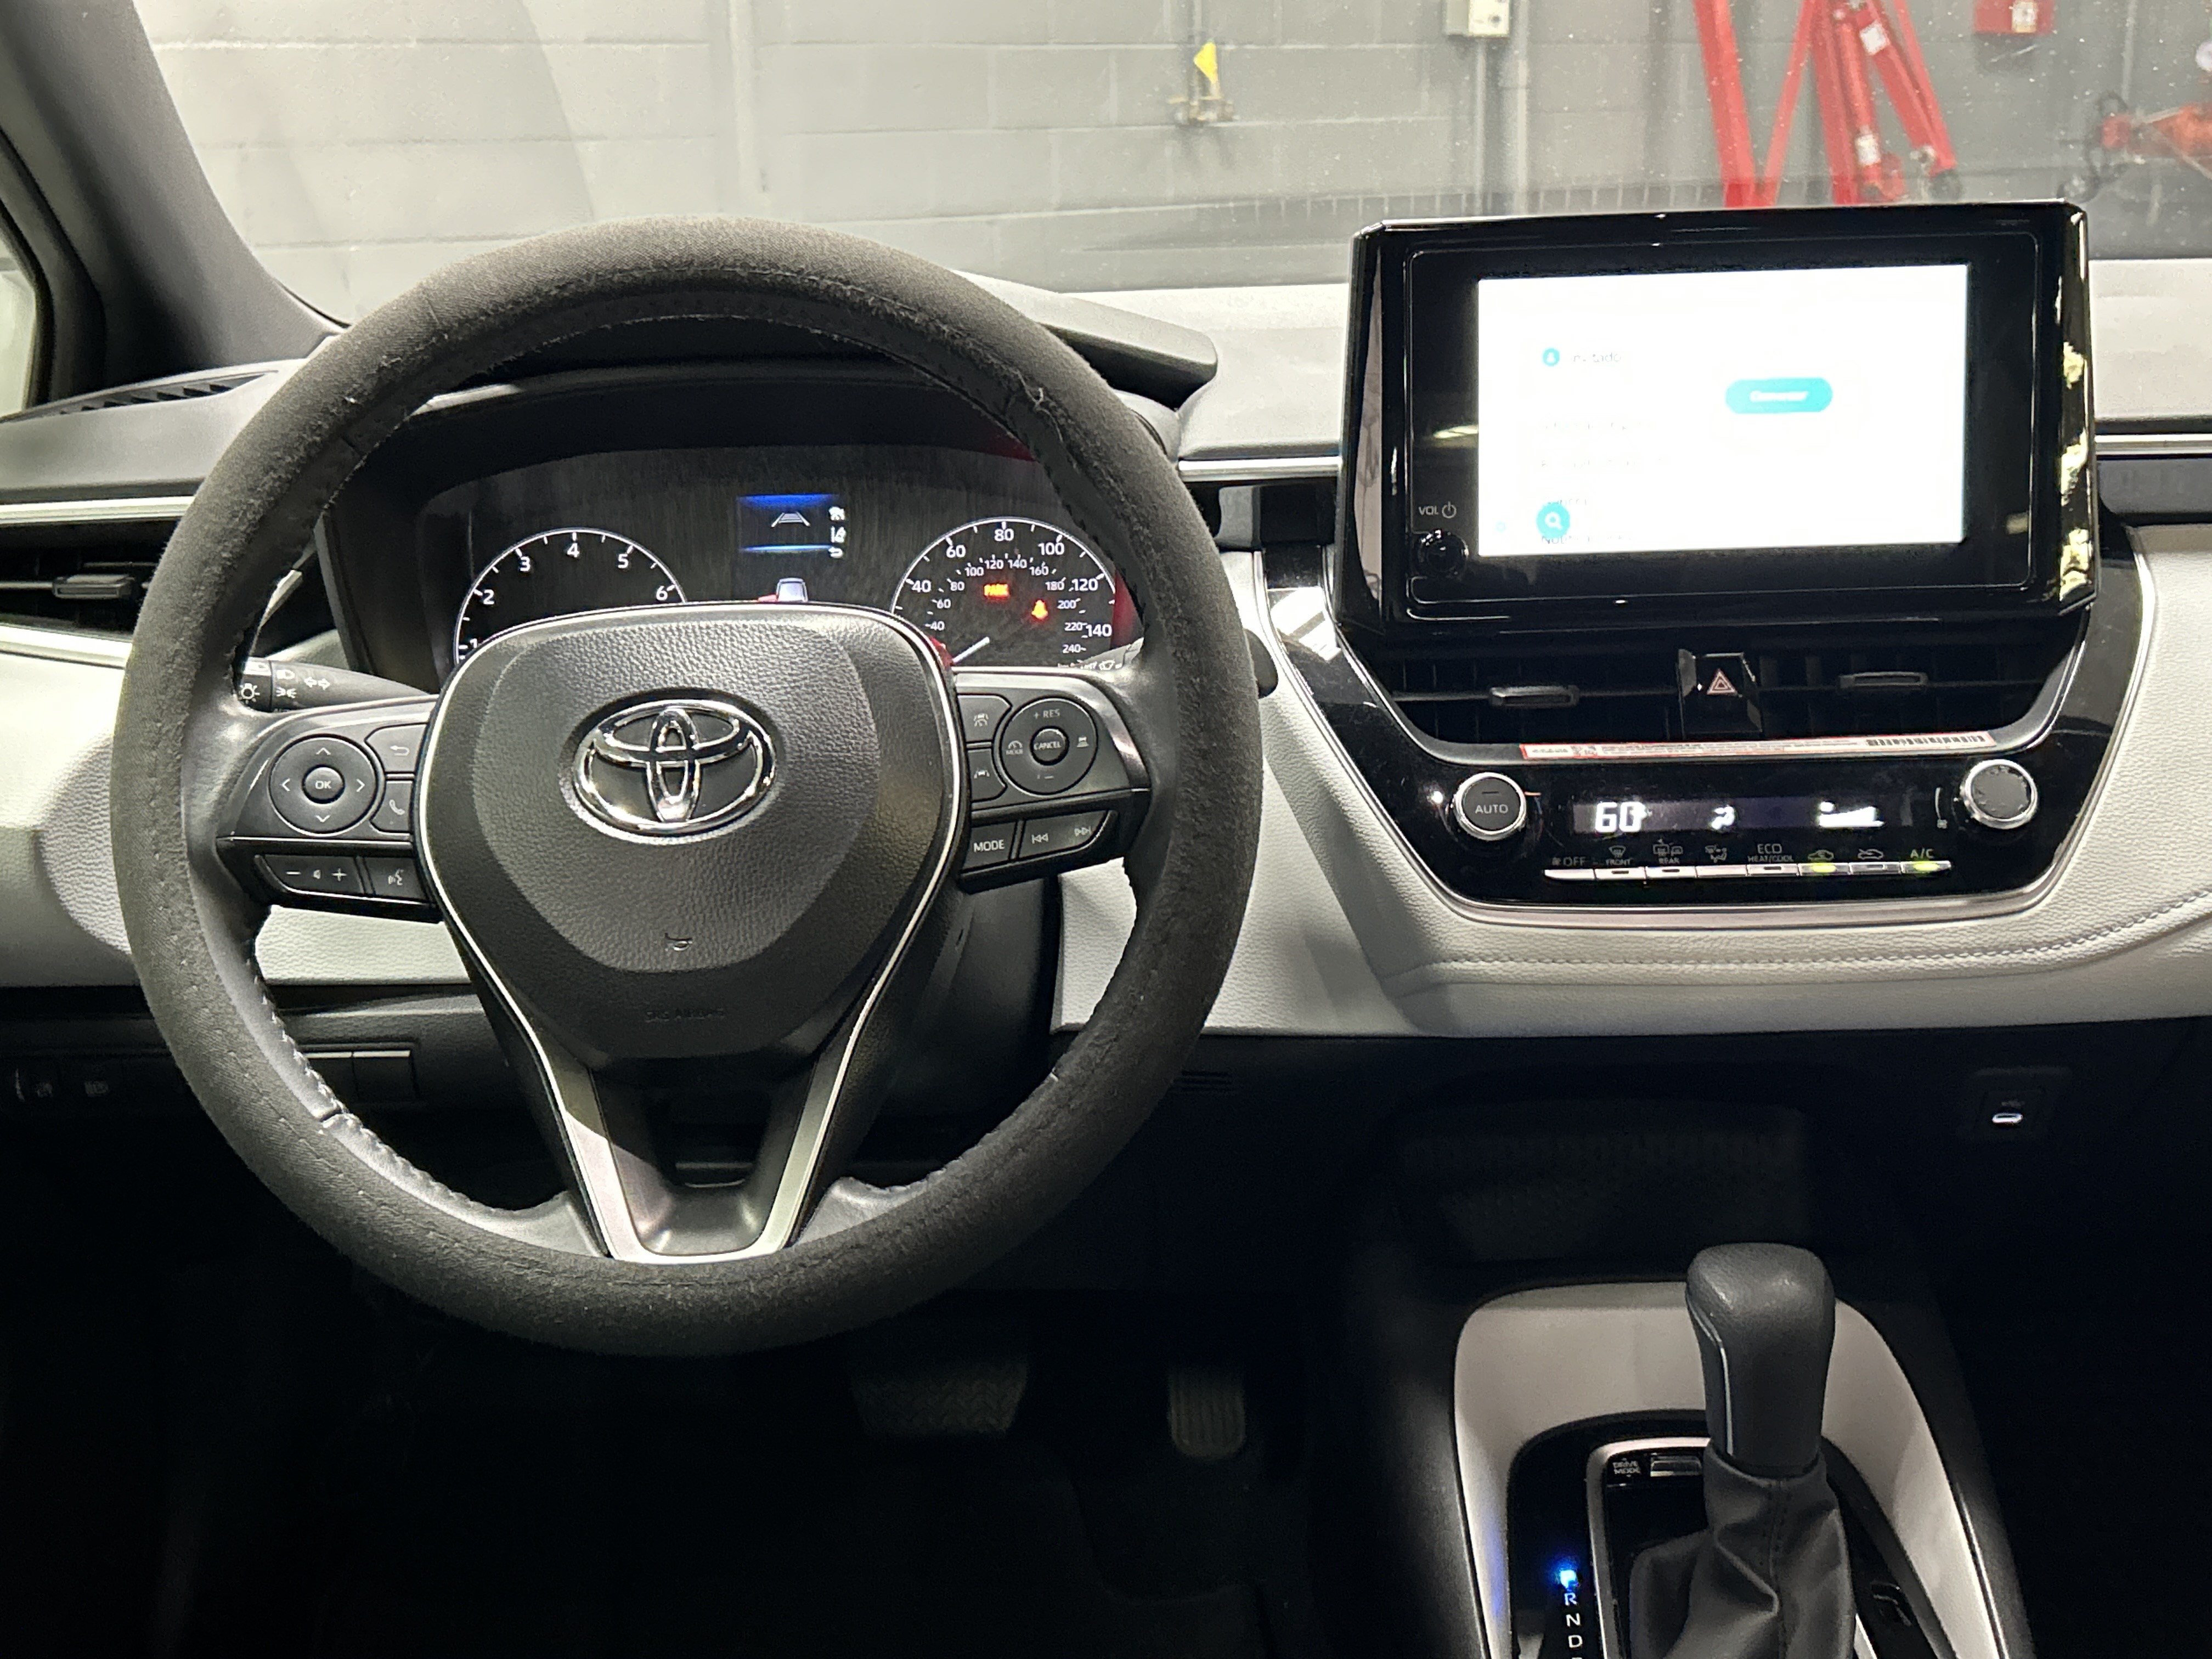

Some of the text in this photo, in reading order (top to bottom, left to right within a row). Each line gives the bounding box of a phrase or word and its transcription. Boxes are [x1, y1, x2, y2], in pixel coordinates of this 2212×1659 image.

[1418, 505, 1440, 516] VOL
[994, 528, 1014, 541] 80
[567, 543, 579, 557] 4
[945, 545, 966, 558] 60
[1039, 542, 1064, 556] 100
[520, 556, 531, 571] 3
[618, 554, 629, 568] 5
[984, 559, 1004, 569] 120
[1008, 559, 1028, 569] 140
[965, 567, 984, 577] 100
[1030, 566, 1049, 576] 160
[912, 579, 932, 592] 40
[950, 582, 965, 591] 80
[1046, 581, 1064, 591] 180
[1073, 578, 1098, 591] 120
[482, 589, 494, 605] 2
[656, 586, 668, 600] 6
[936, 599, 951, 608] 60
[1058, 599, 1076, 609] 200
[931, 620, 945, 630] 40
[1065, 622, 1083, 631] 220
[1086, 624, 1112, 637] 140
[470, 639, 478, 648] 1
[1062, 644, 1081, 653] 240
[1043, 709, 1060, 718] RES
[1034, 742, 1061, 751] CANCEL
[315, 780, 331, 789] OK
[1475, 803, 1508, 814] AUTO
[1595, 802, 1644, 833] 60
[973, 839, 1005, 853] MODE
[1757, 843, 1782, 854] ECO
[1748, 854, 1794, 864] HEAT/COOL
[1910, 848, 1934, 859] A/C
[1564, 856, 1586, 866] OFF
[1606, 857, 1630, 866] FRONT
[1564, 1593, 1577, 1606] R
[1566, 1613, 1582, 1627] N
[1568, 1634, 1583, 1649] D
